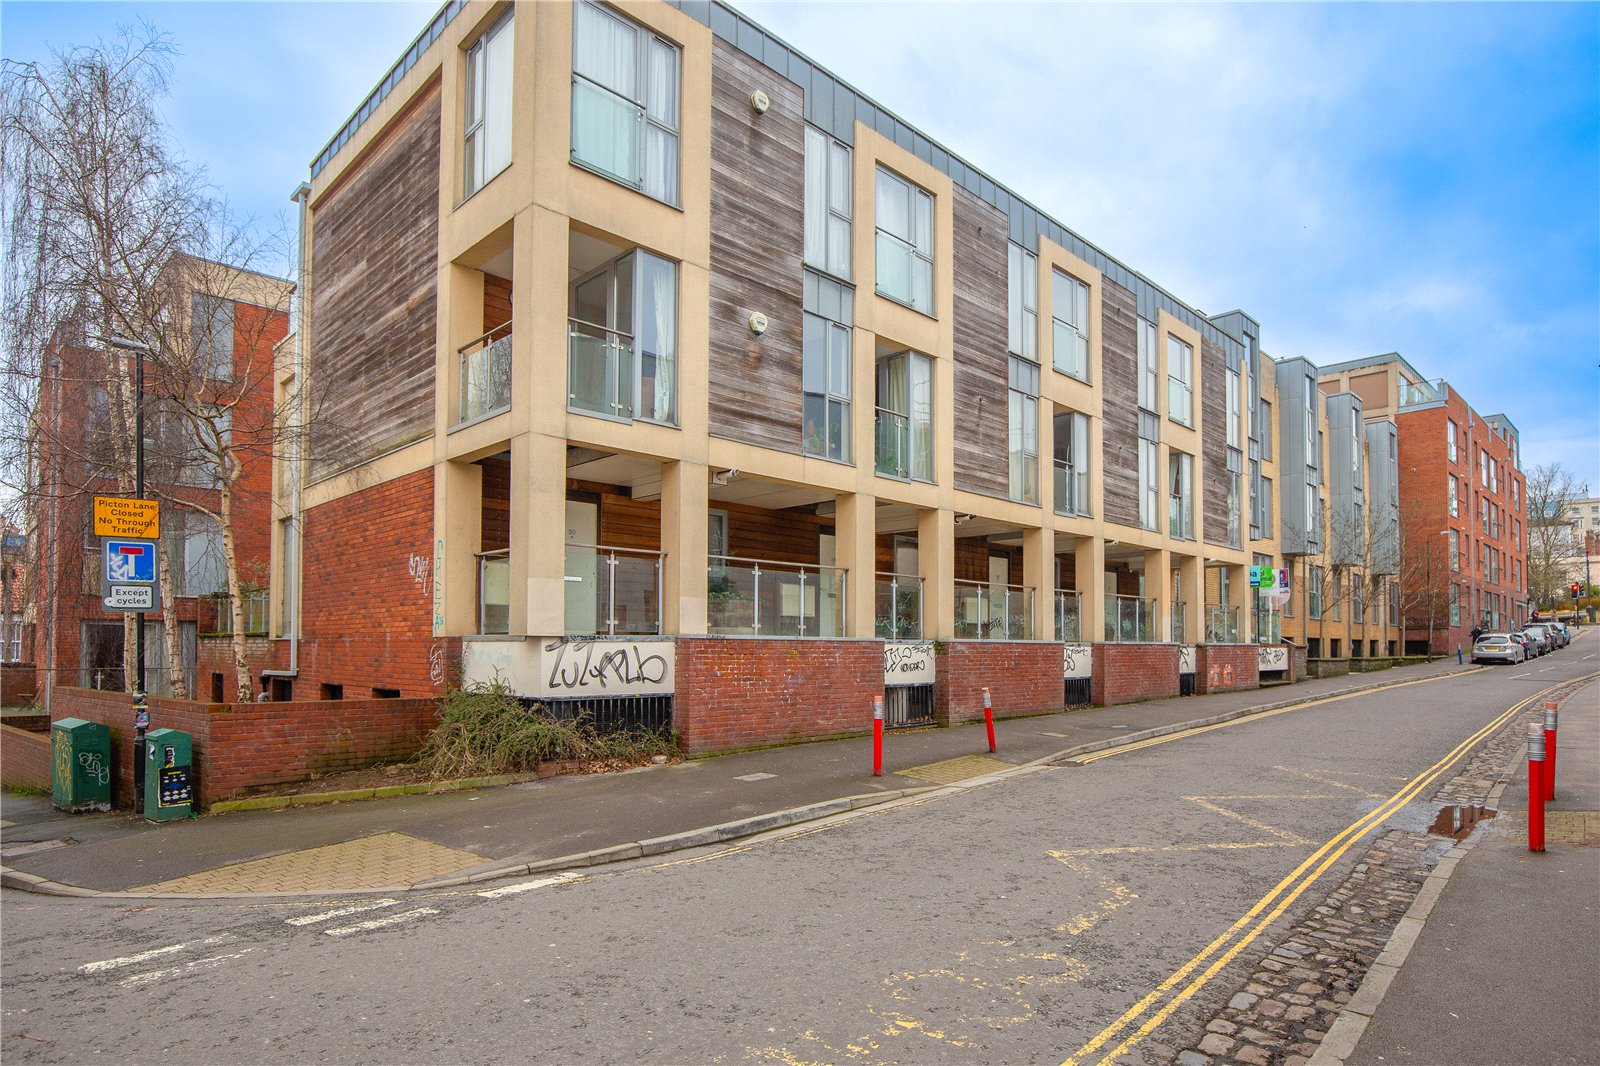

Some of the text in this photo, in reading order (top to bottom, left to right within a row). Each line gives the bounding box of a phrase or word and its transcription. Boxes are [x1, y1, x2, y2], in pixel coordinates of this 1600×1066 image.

[98, 500, 155, 511] Picton Lane
[110, 509, 144, 518] Closed
[98, 517, 156, 528] No Through
[112, 526, 143, 535] Traffic
[115, 589, 149, 598] Except
[116, 597, 147, 606] cycles
